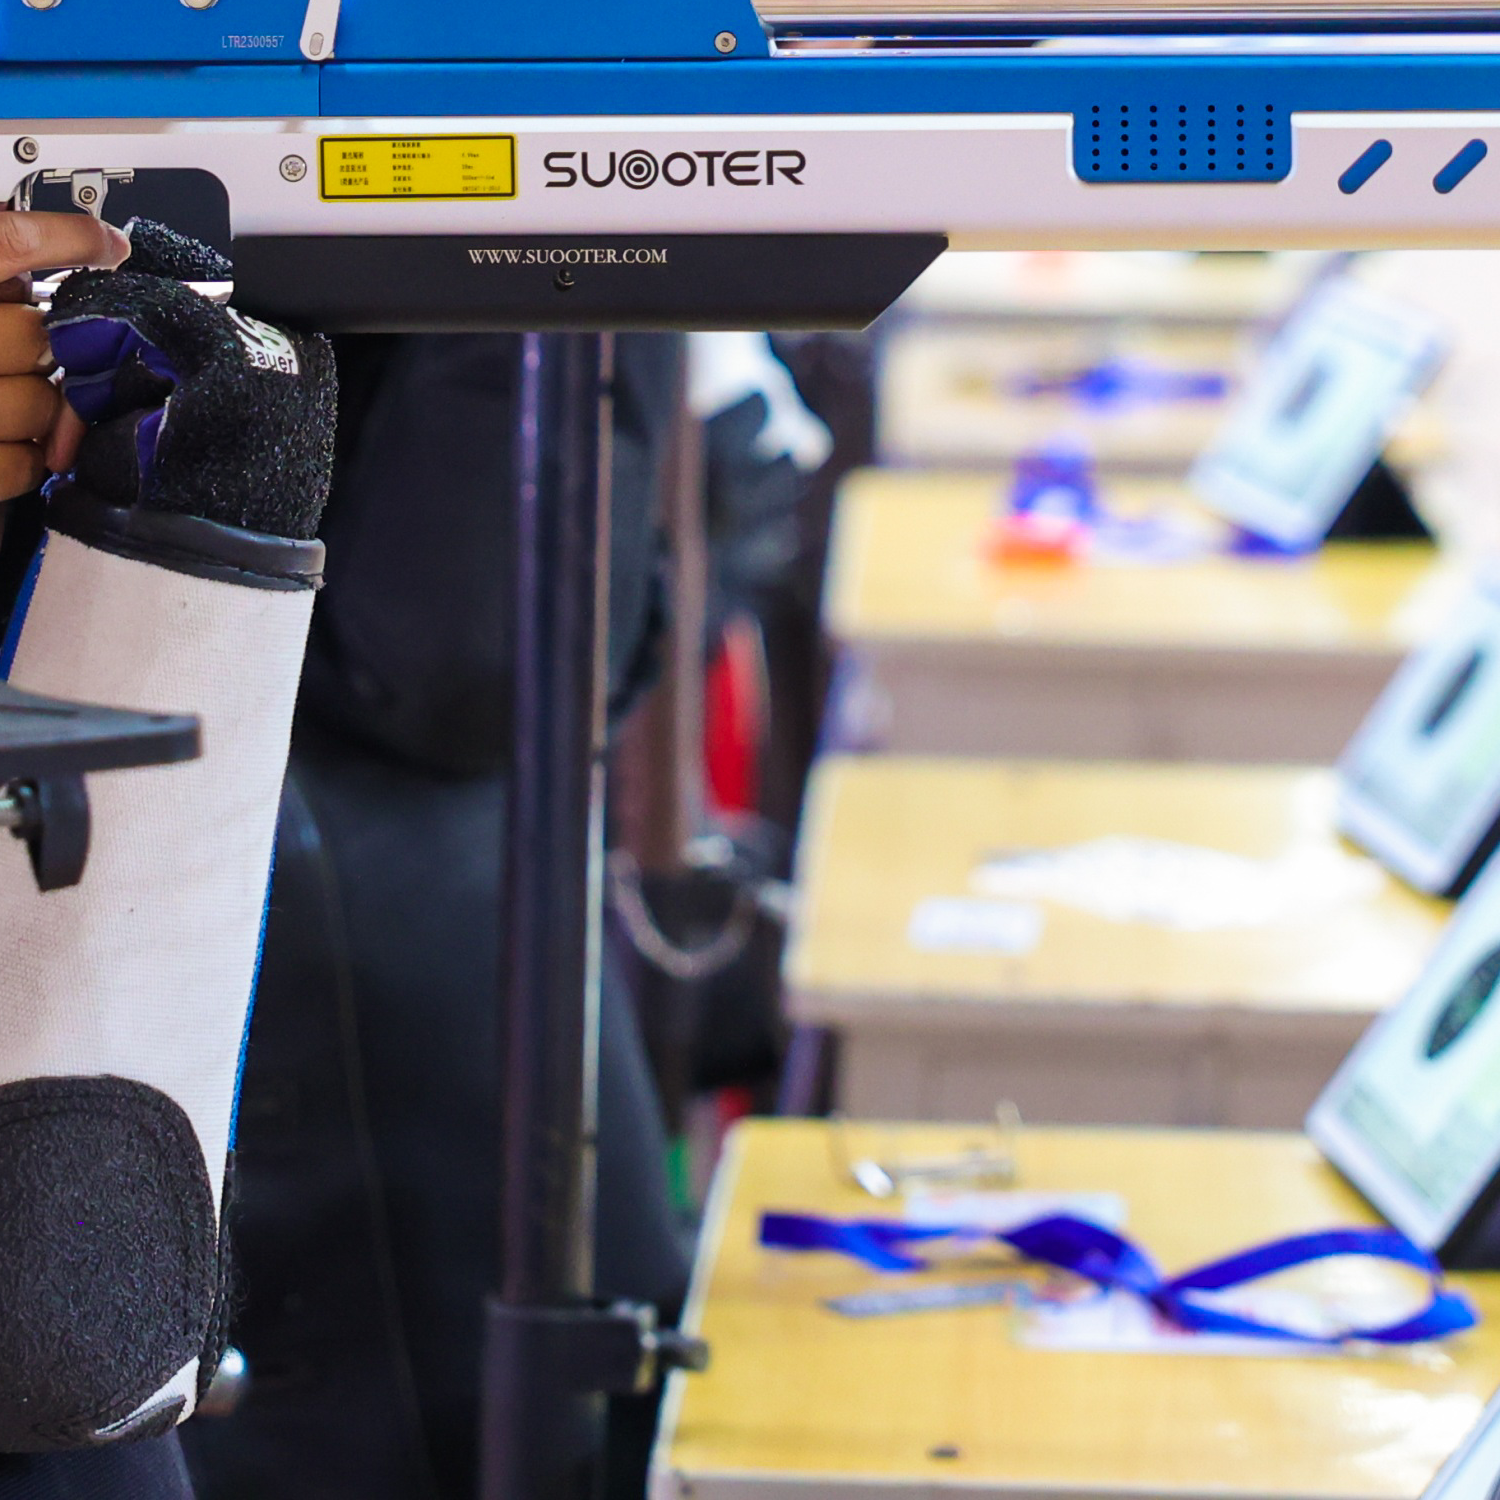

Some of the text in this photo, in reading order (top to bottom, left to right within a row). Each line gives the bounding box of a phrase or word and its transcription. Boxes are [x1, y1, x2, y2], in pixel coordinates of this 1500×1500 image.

[221, 35, 285, 48] LTR2300557
[543, 148, 806, 191] SUOOTER
[467, 247, 668, 266] WWW.SUOOTER.COM
